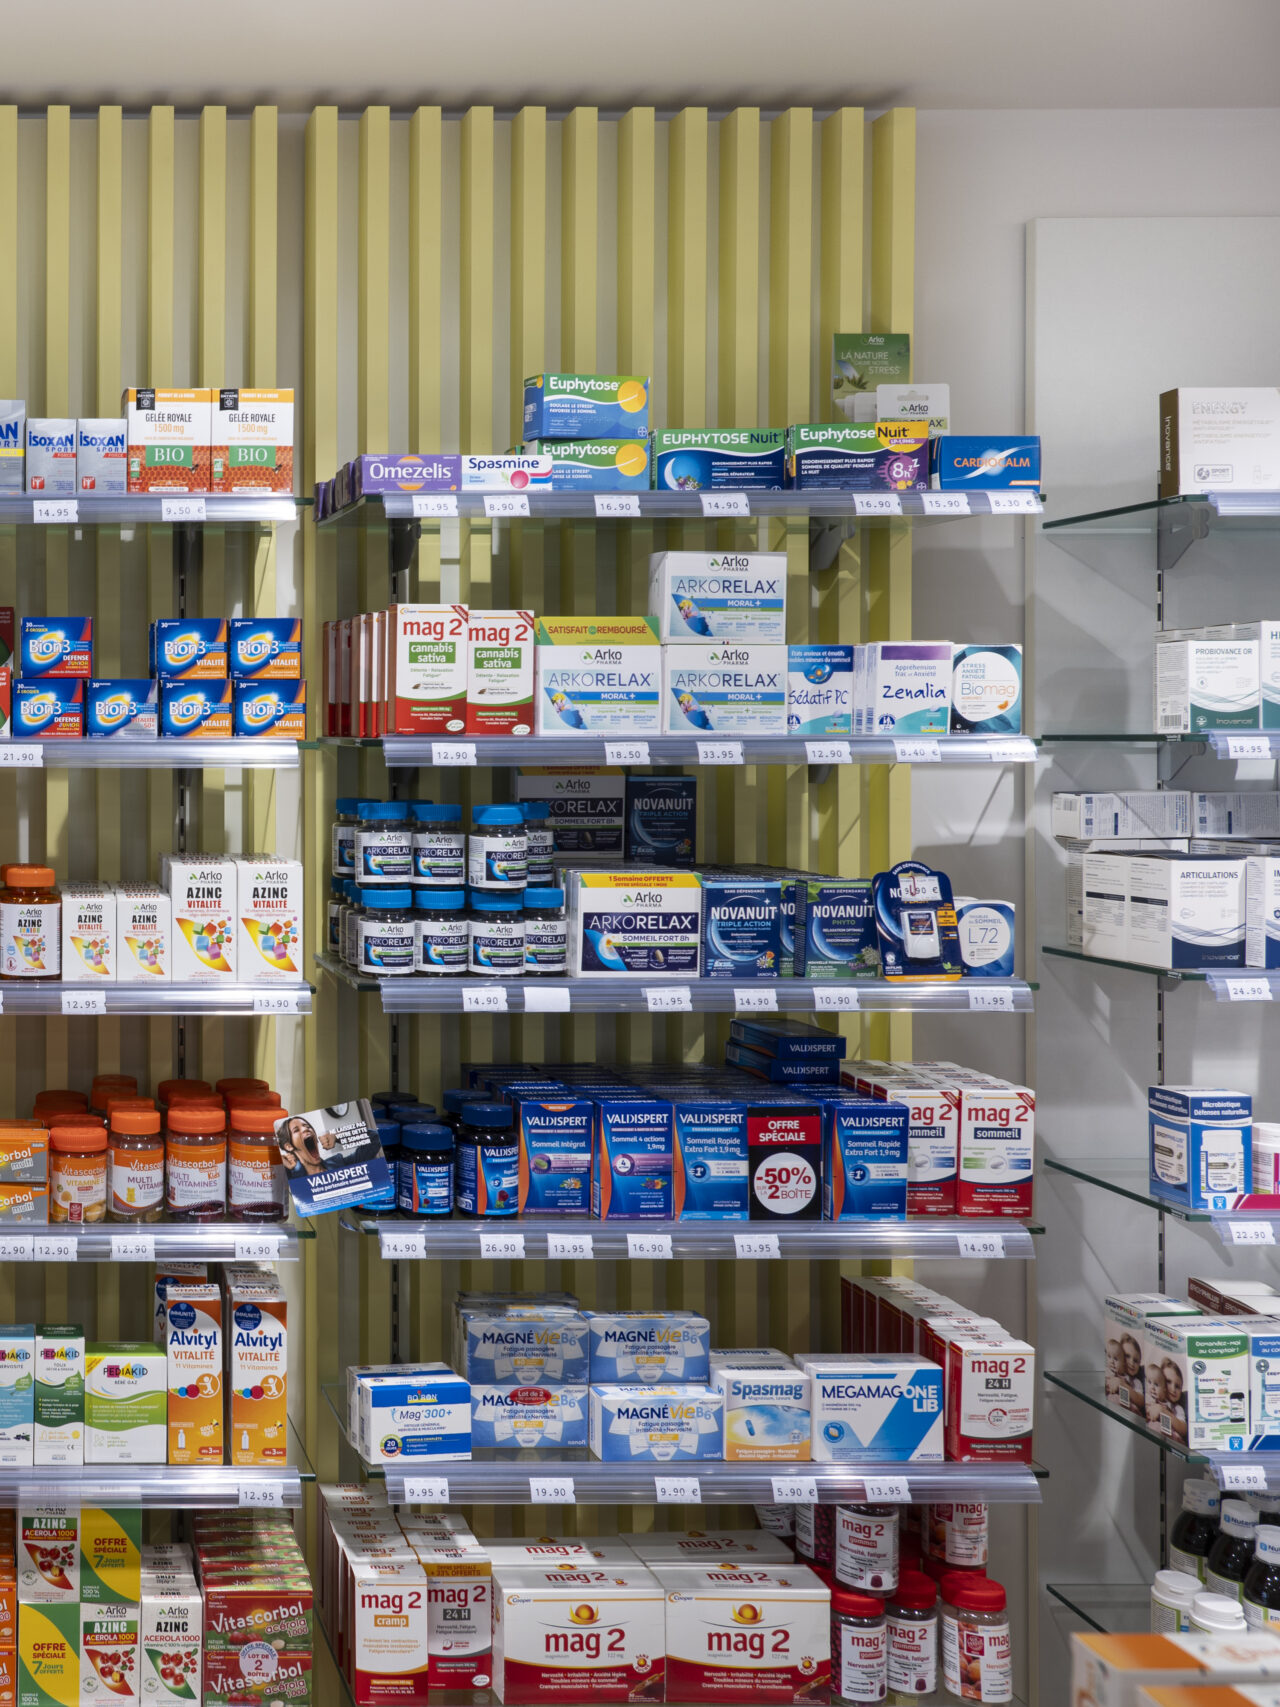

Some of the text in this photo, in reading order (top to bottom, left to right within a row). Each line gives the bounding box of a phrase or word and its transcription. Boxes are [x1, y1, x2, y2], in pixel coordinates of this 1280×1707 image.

[841, 351, 888, 360] LA NATURE
[869, 366, 900, 374] STRESS
[550, 377, 618, 391] Euphytose
[1192, 401, 1247, 414] ENERGY
[146, 412, 192, 422] GELÉE ROYALE
[663, 432, 778, 445] EUPHYTOSE Nuit
[800, 426, 908, 442] Euphytose Nuit
[154, 448, 184, 460] BIO
[469, 458, 539, 470] Spasmine
[954, 457, 1030, 468] CARDIOCALM
[370, 463, 452, 479] Omezelis
[418, 503, 448, 511] 11.95
[403, 619, 462, 641] mag 2
[597, 624, 647, 634] REMBOURSÉ
[29, 640, 70, 654] Bion3
[238, 640, 279, 655] Bion3
[411, 644, 453, 653] cannabis
[1195, 647, 1241, 655] PROBIOVANCE
[196, 657, 224, 666] VITALITÉ
[418, 653, 445, 662] sativa
[549, 672, 651, 687] ARKORELAX
[883, 683, 945, 699] Zenalia
[962, 683, 1014, 698] Biomag
[834, 691, 848, 704] PC
[1233, 745, 1262, 753] 18.95
[438, 752, 467, 760] 12.90
[634, 798, 693, 810] NOVANUIT
[187, 888, 222, 898] AZINC
[711, 906, 776, 919] NOVANUIT
[590, 915, 691, 929] ARKORELAX
[968, 928, 998, 944] L72
[1202, 1101, 1240, 1109] Microbiotique
[526, 1116, 587, 1126] VALDISPERT
[680, 1114, 743, 1123] VALDISPERT
[968, 1106, 1028, 1126] mag 2
[768, 1120, 799, 1129] OFFRE
[759, 1129, 806, 1141] SPÉCIALE
[976, 1129, 1019, 1138] sommeil
[561, 1140, 585, 1148] Intégral
[308, 1165, 368, 1187] VALDISPERT
[756, 1167, 811, 1184] -50%
[782, 1187, 811, 1199] BOÎTE
[170, 1329, 218, 1349] Alvityl
[173, 1349, 214, 1360] VITALITÉ
[104, 1368, 148, 1376] PEDIAKID
[972, 1358, 1025, 1376] mag 2
[988, 1379, 1009, 1388] 24 H
[732, 1381, 803, 1399] Spasmag
[913, 1400, 939, 1413] LIB
[244, 1491, 274, 1500] 12.95
[535, 1488, 565, 1496] 19.90
[33, 1519, 66, 1528] AZINC
[25, 1530, 56, 1538] ACEROLA
[94, 1538, 127, 1546] OFFRE
[361, 1592, 421, 1613] mag 2
[211, 1602, 303, 1633] Vitascorbol
[377, 1617, 406, 1627] cramp
[545, 1629, 625, 1659] mag 2
